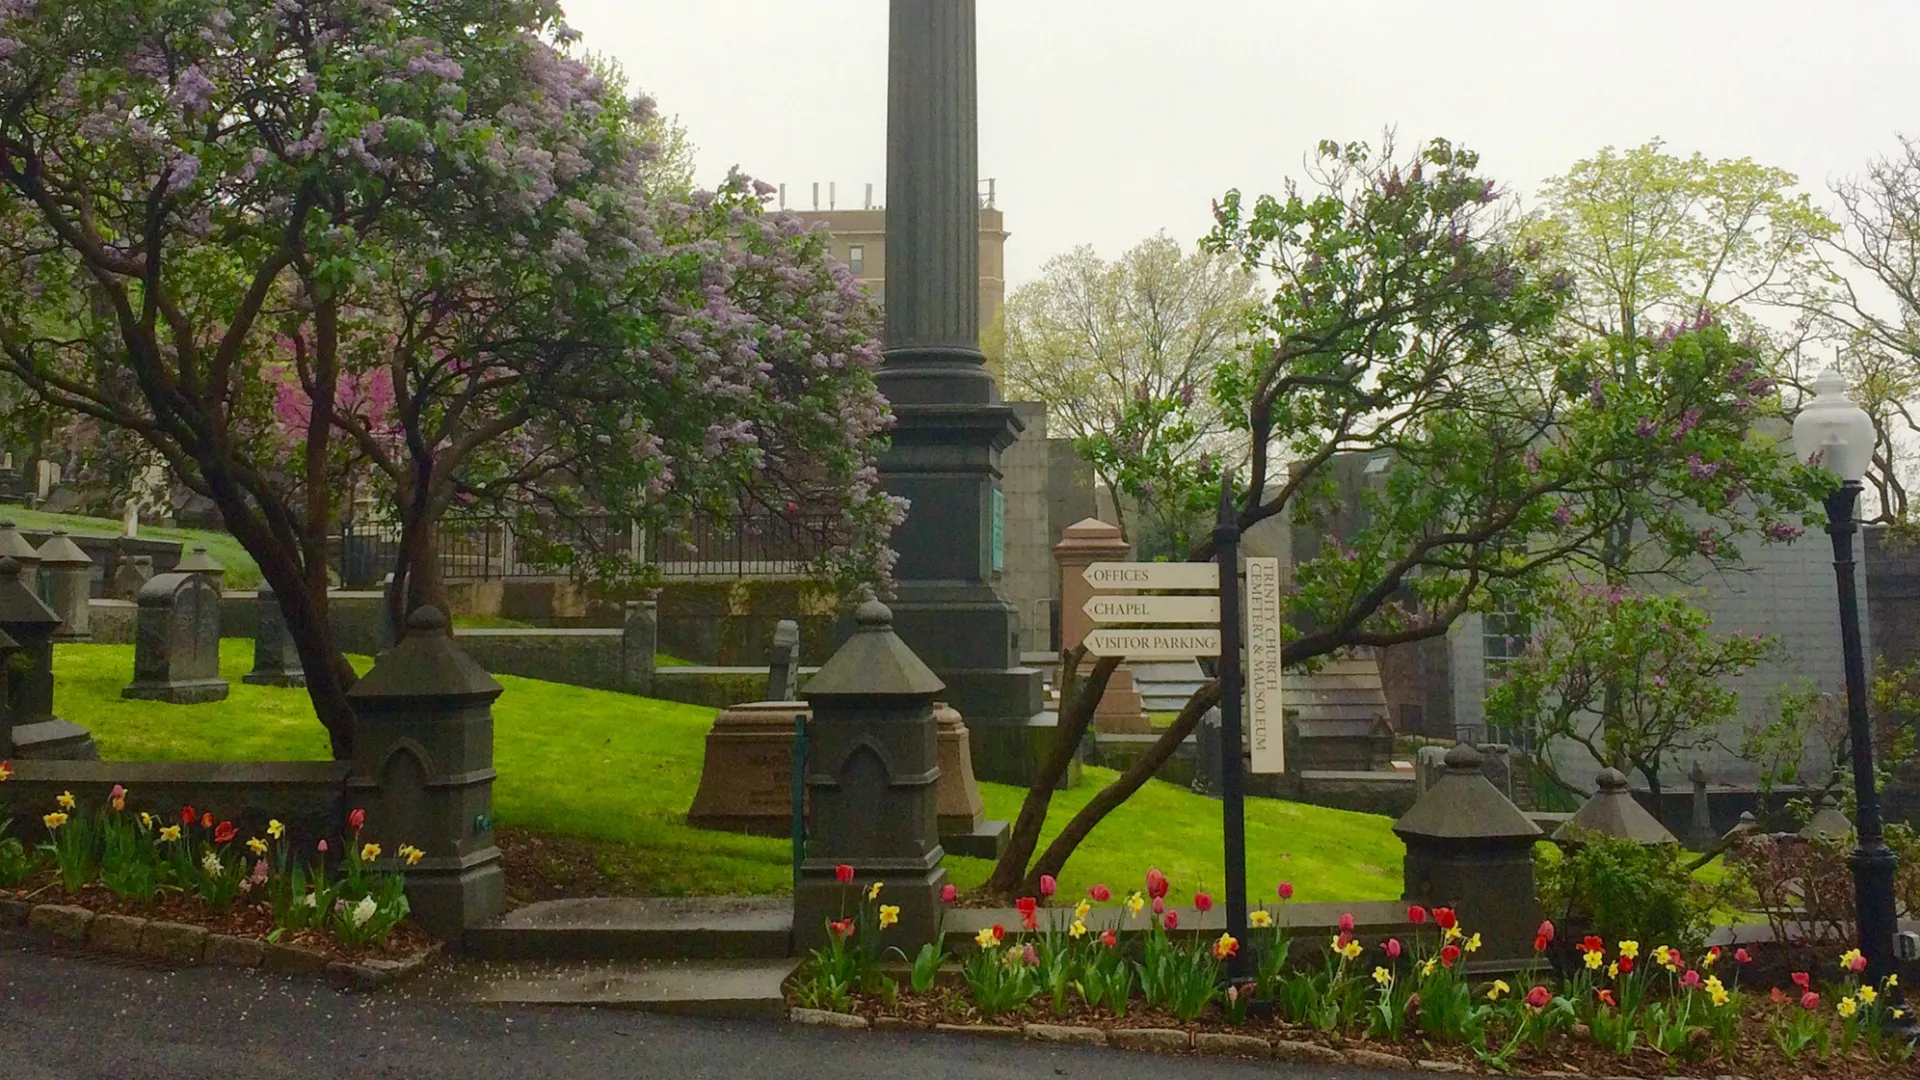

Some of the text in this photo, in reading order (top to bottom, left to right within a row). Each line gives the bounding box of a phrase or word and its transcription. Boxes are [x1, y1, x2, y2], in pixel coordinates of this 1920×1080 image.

[1093, 569, 1149, 581] OFFICES
[1094, 603, 1149, 615] CHAPEL
[1263, 563, 1277, 691] TRINITY CHURCH
[1095, 636, 1215, 649] VISITOR PARKING
[1251, 563, 1267, 751] CEMETERY & MAUSOLEUM
